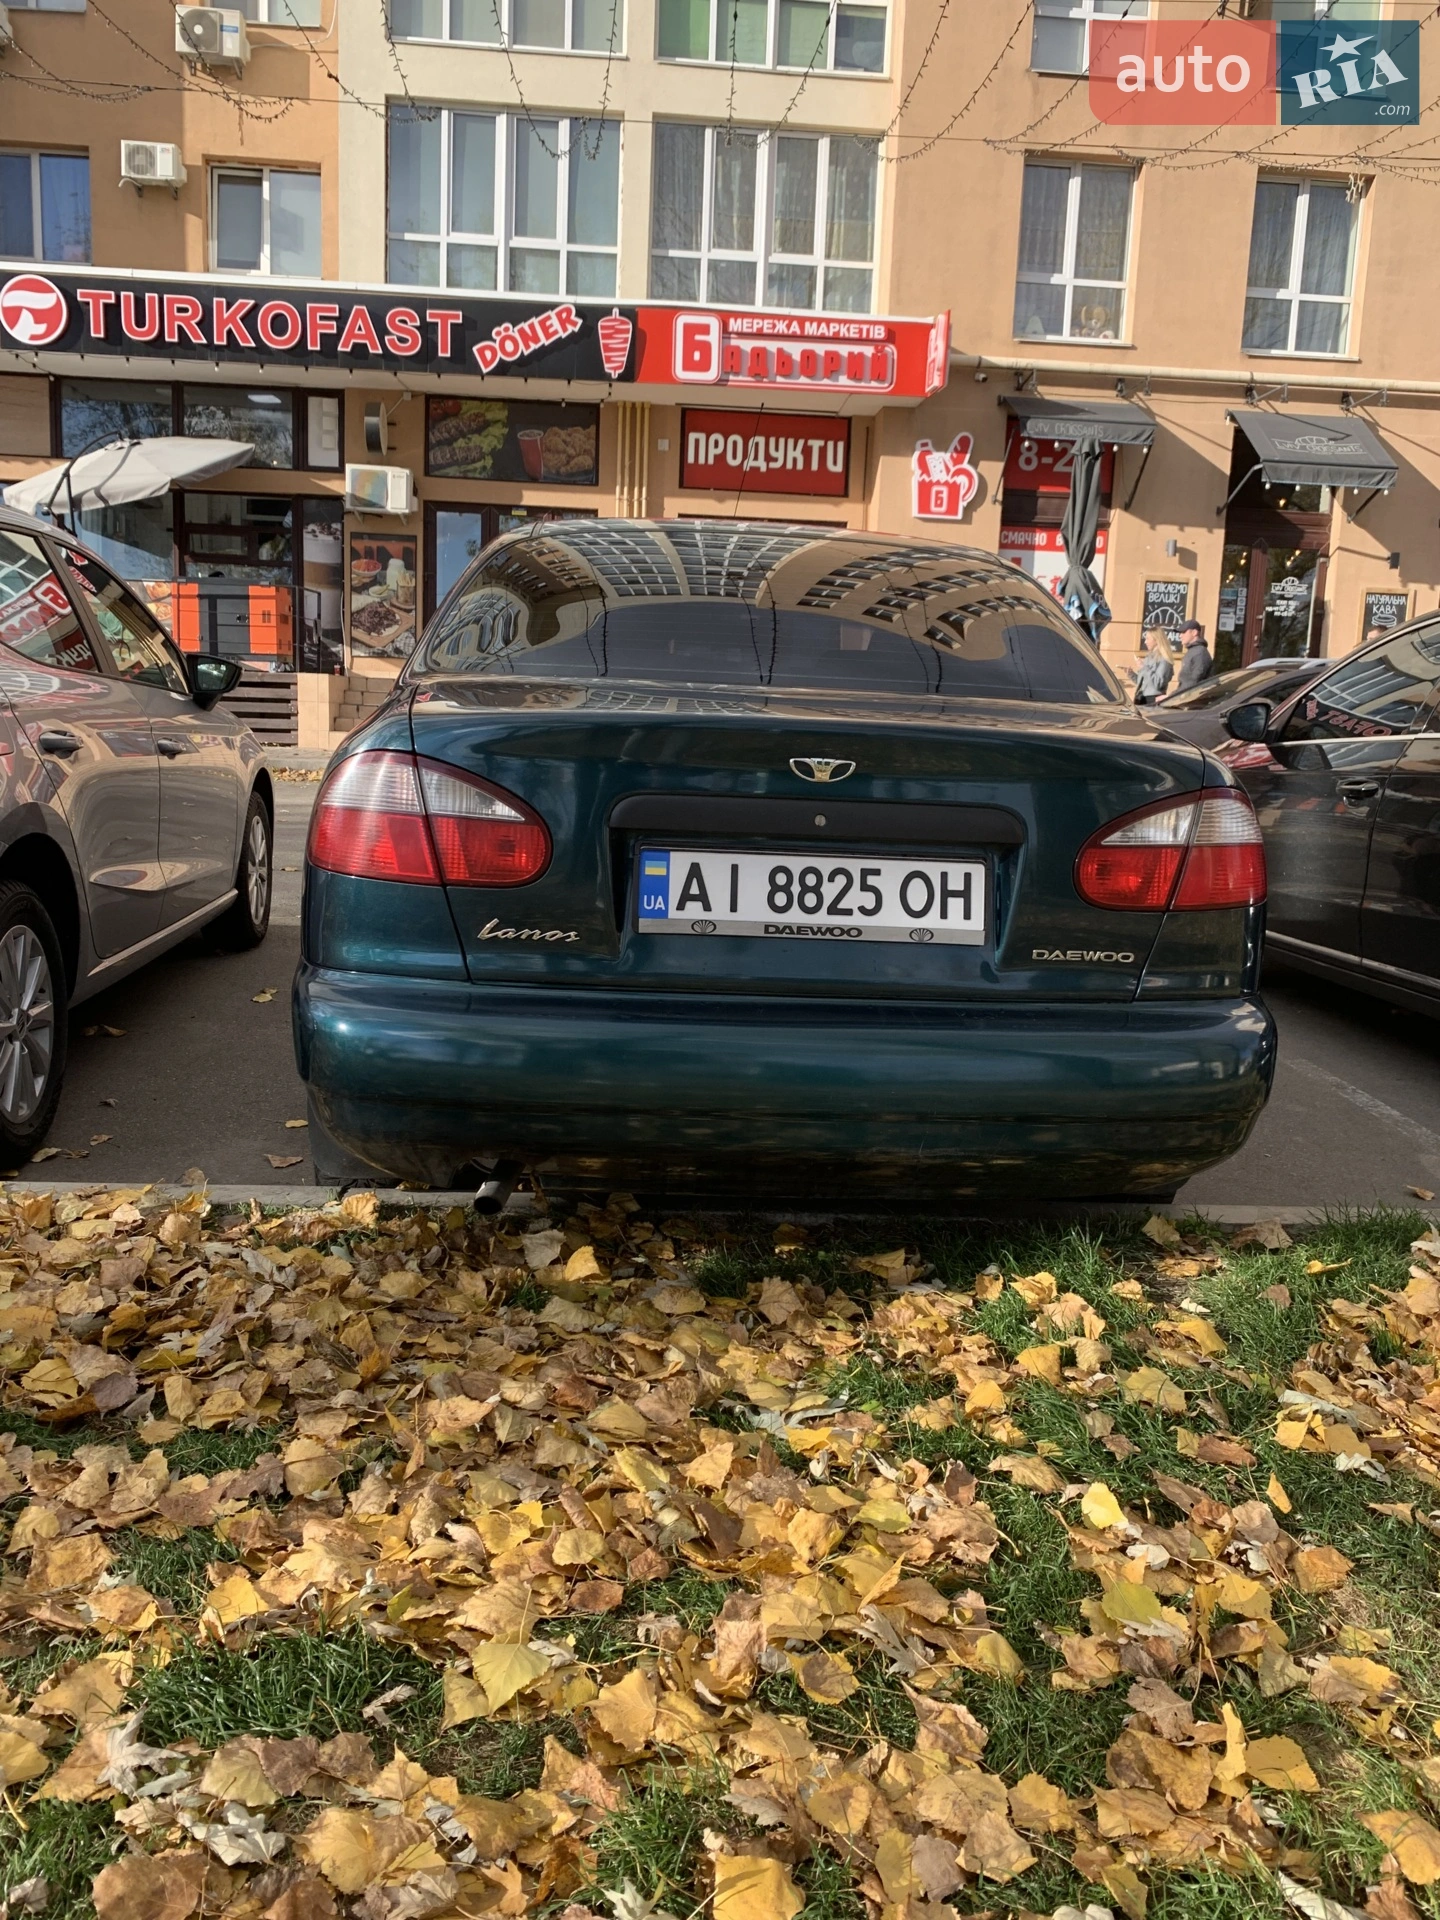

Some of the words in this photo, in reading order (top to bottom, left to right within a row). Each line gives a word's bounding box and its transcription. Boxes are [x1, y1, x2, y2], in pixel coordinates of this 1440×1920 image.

[77, 288, 462, 358] TURKOFAST
[728, 317, 801, 335] МЕРЕЖА
[804, 321, 885, 339] МАРКЕТІВ
[472, 304, 583, 374] DÖNER
[687, 432, 845, 472] ПРОДУКТИ
[1018, 440, 1075, 472] 8-2
[1001, 530, 1047, 546] СМАЧНО
[1366, 594, 1407, 605] НАТУРАЛЬНА
[1372, 604, 1398, 614] КАВА
[643, 895, 666, 910] UA
[767, 865, 883, 917] 8825
[899, 870, 972, 921] OH
[477, 918, 580, 942] Lanos
[763, 924, 863, 938] DAEWOO
[1031, 949, 1135, 963] DAEWOO
